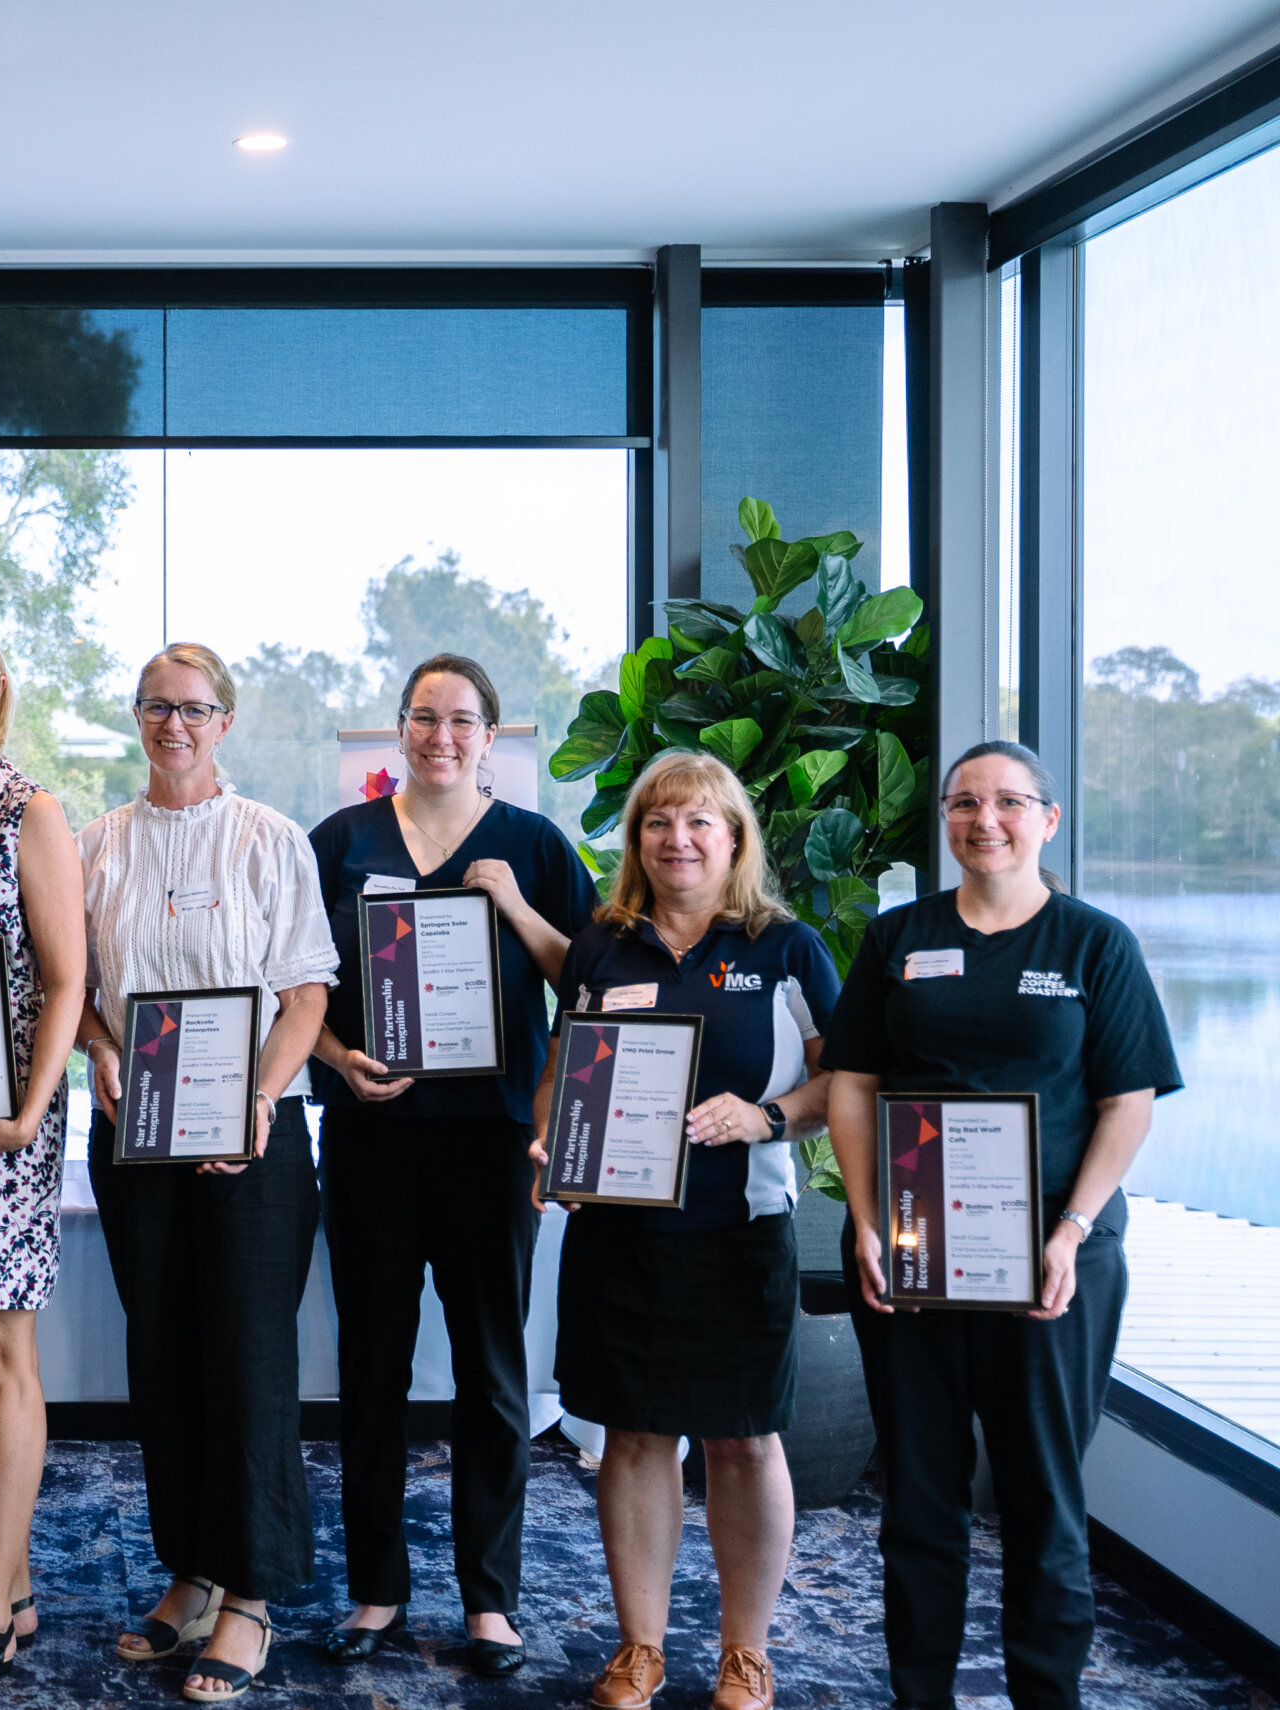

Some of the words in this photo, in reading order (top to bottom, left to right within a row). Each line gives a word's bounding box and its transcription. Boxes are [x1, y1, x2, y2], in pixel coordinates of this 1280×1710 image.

[708, 973, 762, 988] VMG
[1019, 979, 1066, 989] COFFEE
[1021, 970, 1063, 981] WOLFF
[381, 977, 394, 1037] Partnership
[385, 1038, 395, 1060] Star
[394, 999, 407, 1059] Recognition
[136, 1070, 152, 1125] Partnership
[146, 1090, 160, 1146] Recognition
[134, 1126, 145, 1147] Star
[564, 1099, 583, 1159] Partnership
[948, 1126, 962, 1134] Big
[561, 1160, 573, 1182] Star
[572, 1122, 590, 1183] Recognition
[899, 1188, 916, 1261] Panership
[914, 1216, 929, 1289] Recognition
[901, 1262, 915, 1289] Star
